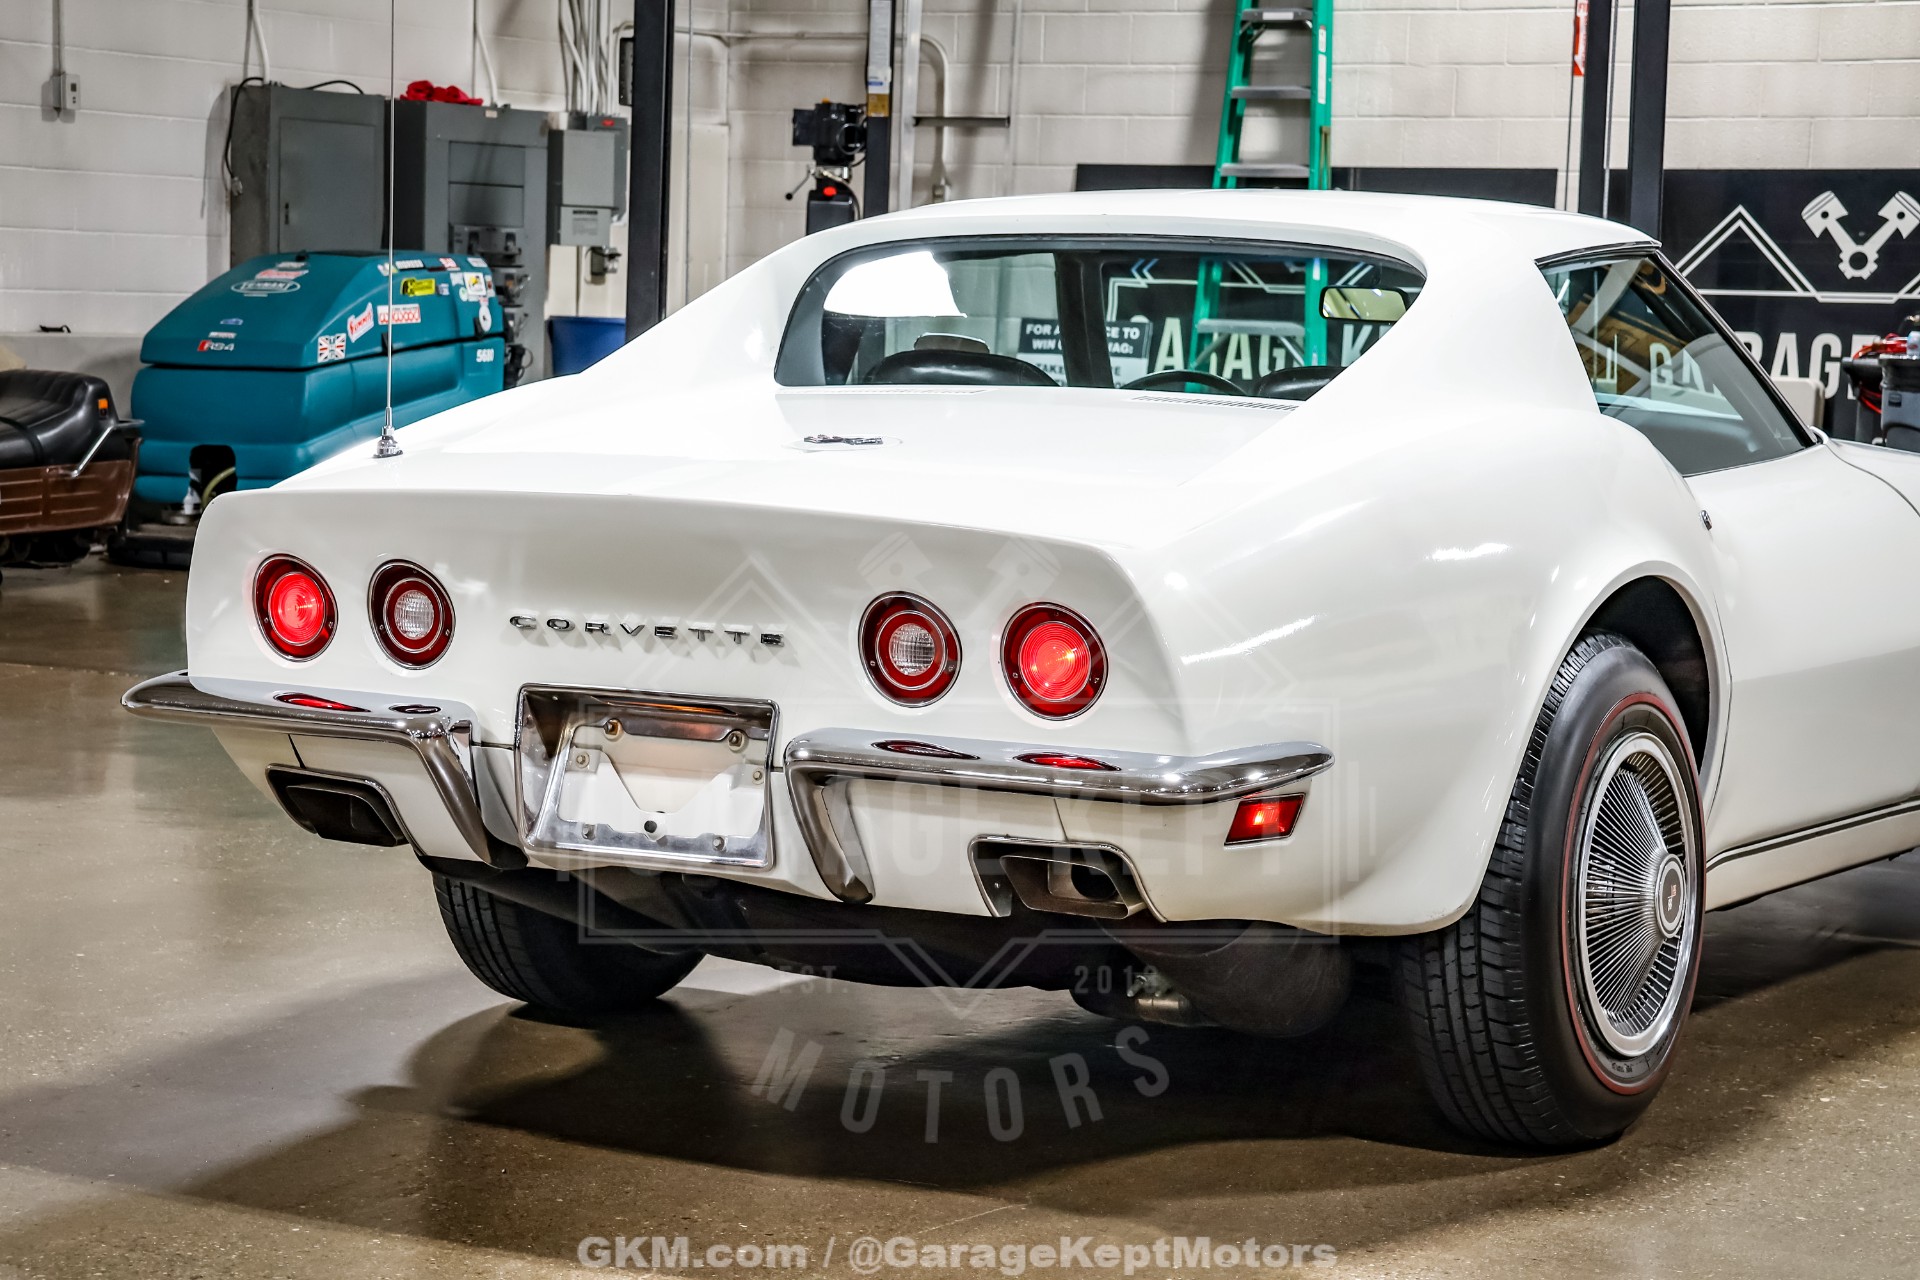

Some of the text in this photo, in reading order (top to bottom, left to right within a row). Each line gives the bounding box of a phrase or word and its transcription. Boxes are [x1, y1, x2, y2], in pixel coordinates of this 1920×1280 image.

[379, 308, 421, 324] wlwood
[1025, 324, 1052, 335] FOR
[1121, 327, 1141, 340] TO
[203, 341, 236, 352] RS4
[1031, 338, 1056, 351] WIN
[1107, 342, 1134, 355] AG:
[509, 614, 785, 648] CORVETTE
